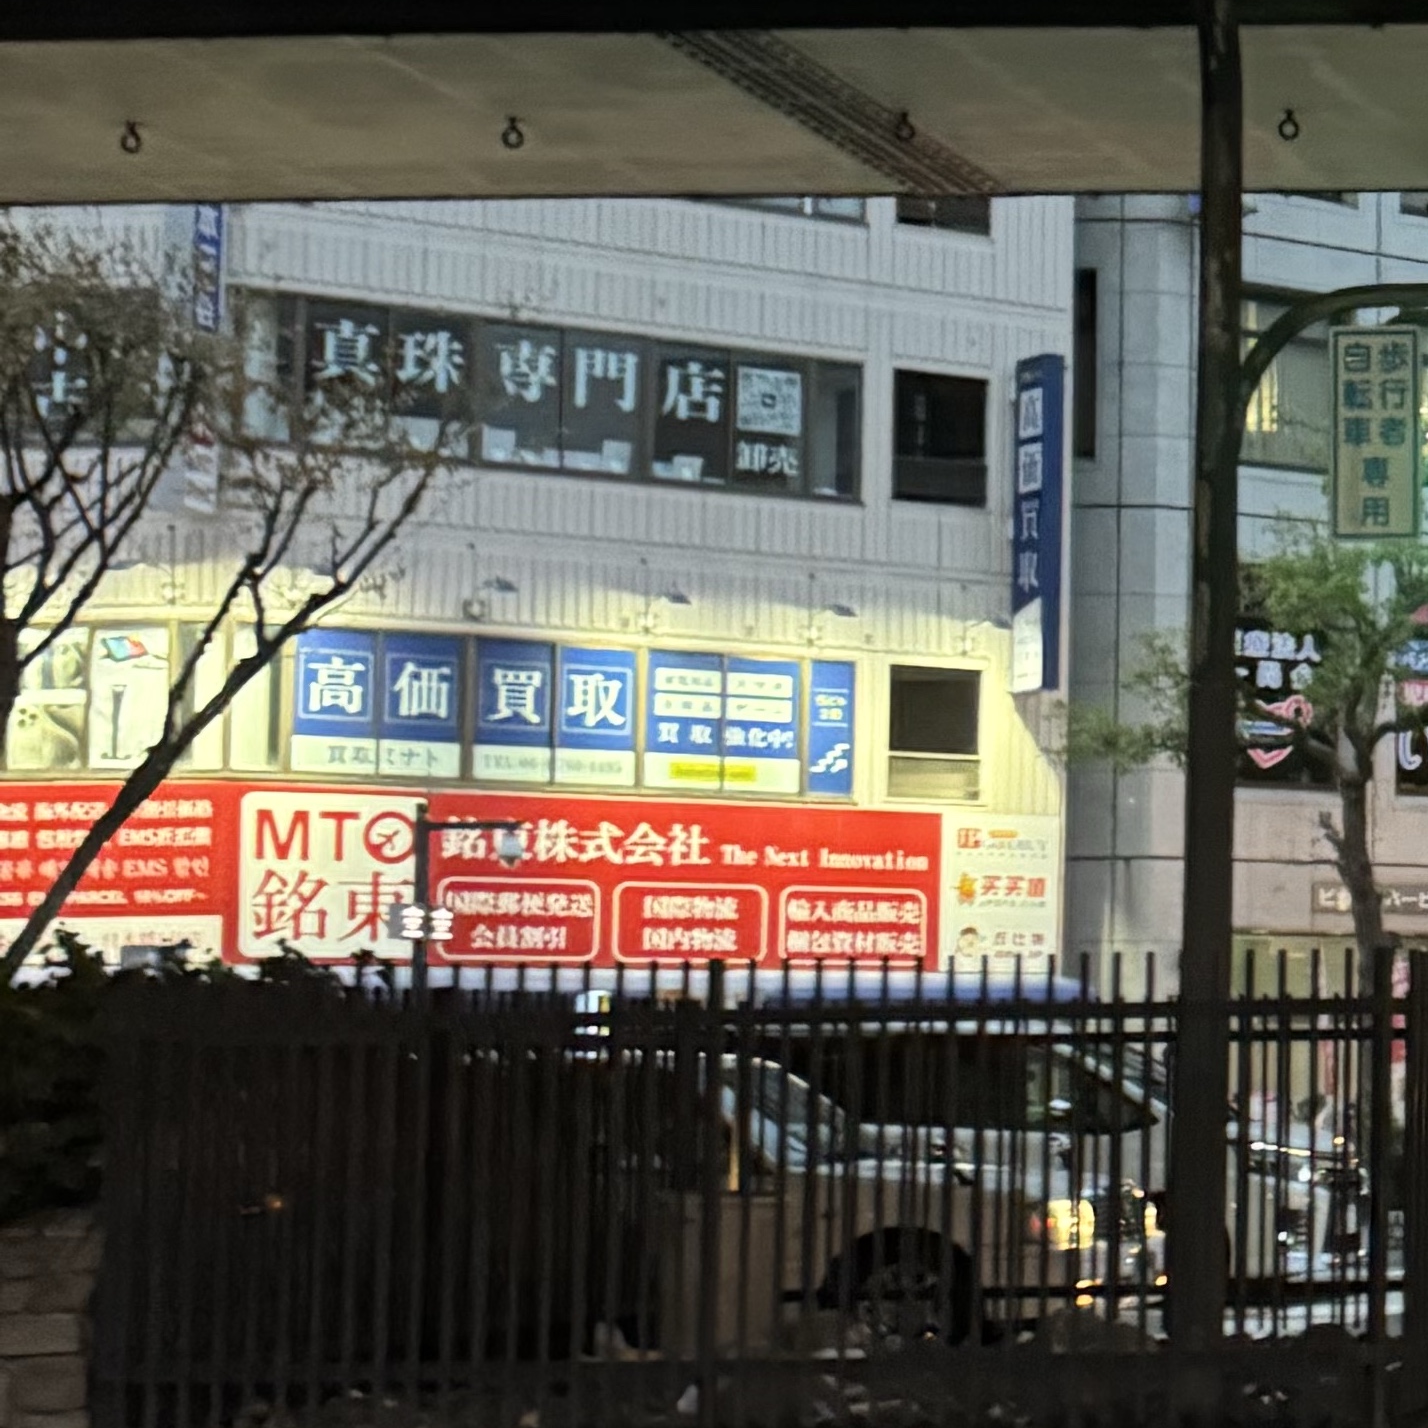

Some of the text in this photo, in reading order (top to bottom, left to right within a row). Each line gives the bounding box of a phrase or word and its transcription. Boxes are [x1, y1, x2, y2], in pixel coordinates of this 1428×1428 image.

[315, 317, 727, 424] 真珠専門店
[735, 441, 799, 477] 卸売
[307, 655, 628, 727] 高価買取
[720, 843, 759, 867] The
[763, 845, 810, 868] Next
[819, 847, 929, 871] Innovation
